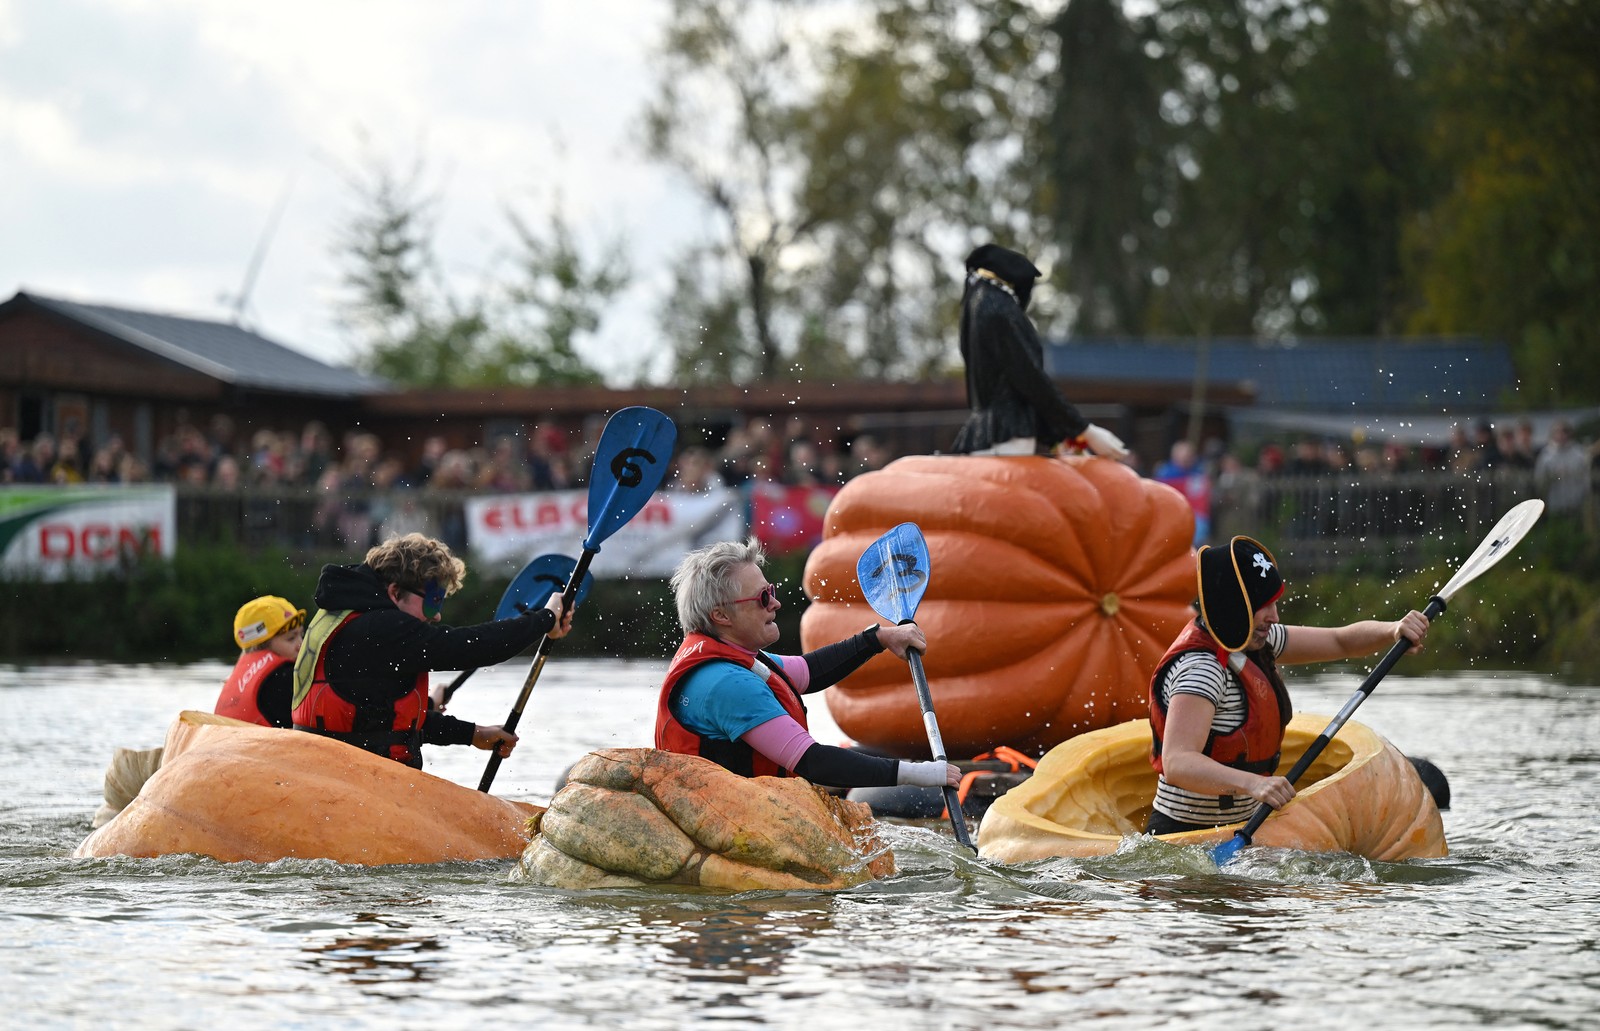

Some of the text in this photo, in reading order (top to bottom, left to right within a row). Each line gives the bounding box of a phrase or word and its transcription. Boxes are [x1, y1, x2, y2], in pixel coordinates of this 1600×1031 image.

[611, 447, 656, 488] 6
[40, 523, 162, 562] DCM
[872, 553, 927, 600] 3
